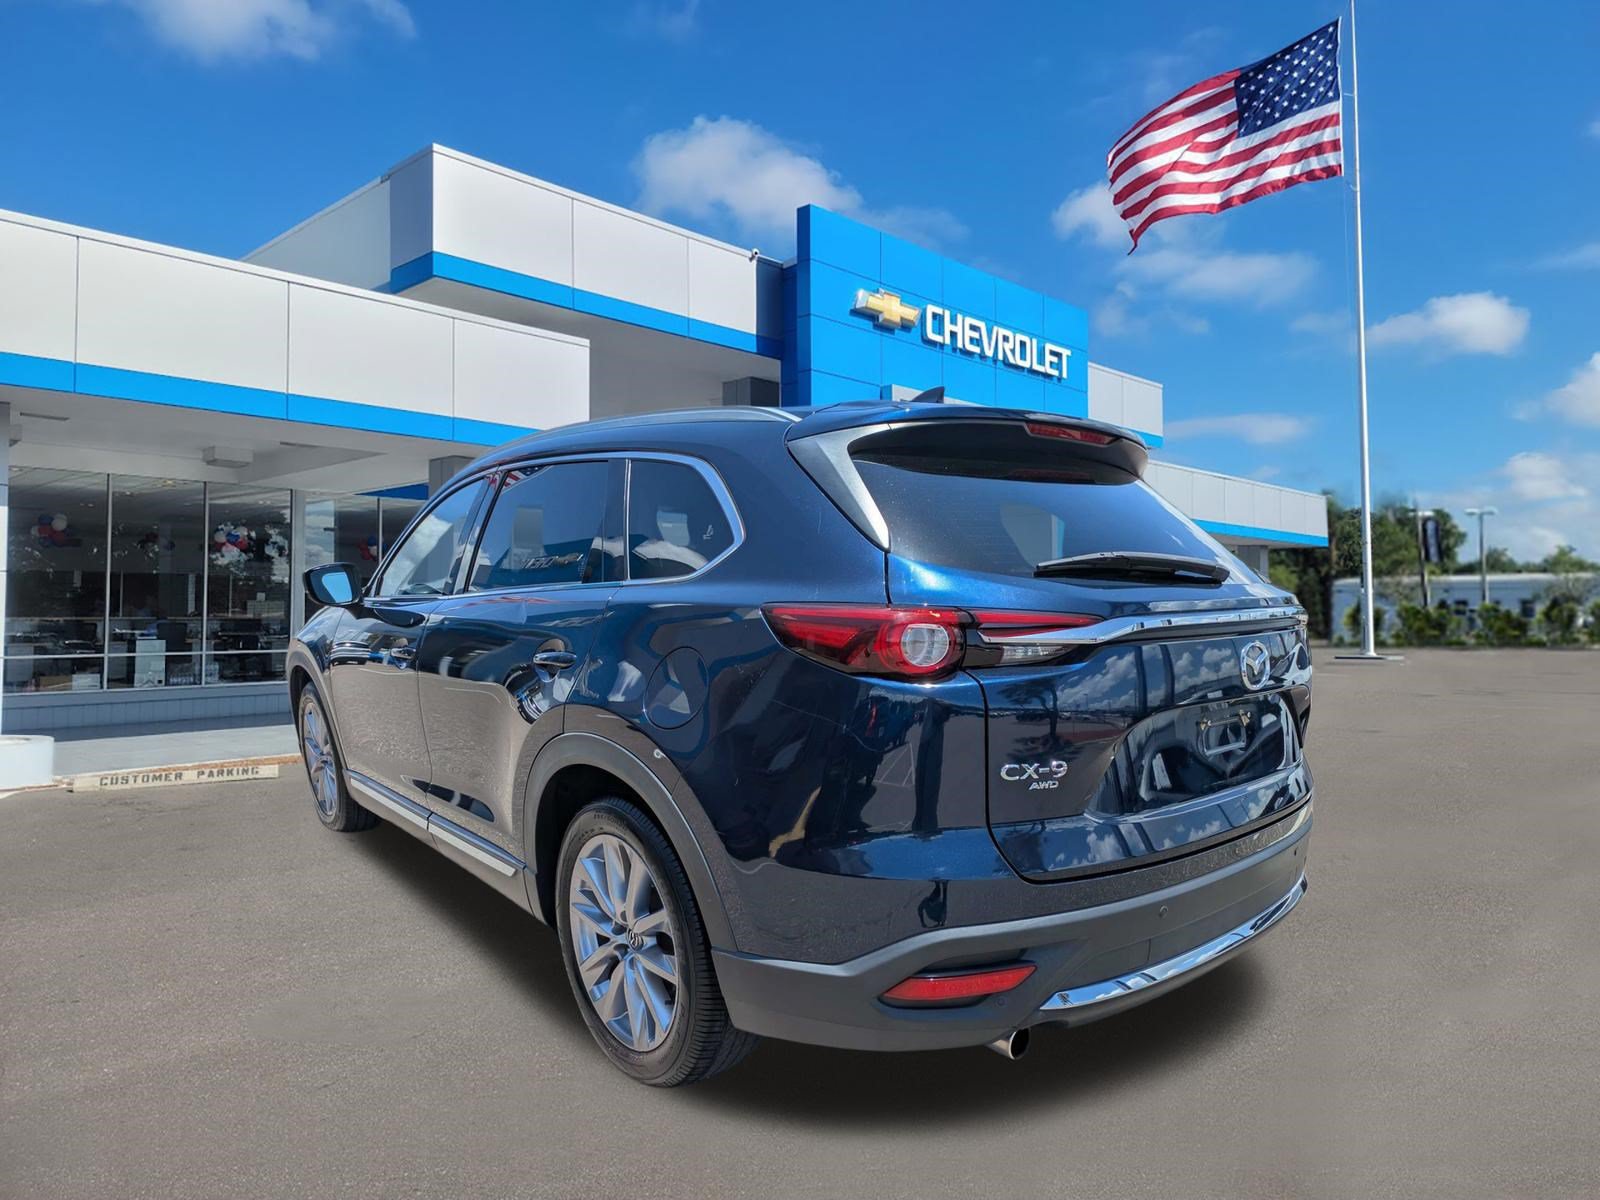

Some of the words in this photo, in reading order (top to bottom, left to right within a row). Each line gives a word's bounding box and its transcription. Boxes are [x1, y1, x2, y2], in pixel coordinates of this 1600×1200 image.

[925, 303, 1072, 379] CHEVROLET
[99, 772, 183, 786] CUSTOMER
[197, 767, 259, 780] PARKING
[1000, 760, 1068, 780] CX-9
[1028, 780, 1059, 790] AWD
